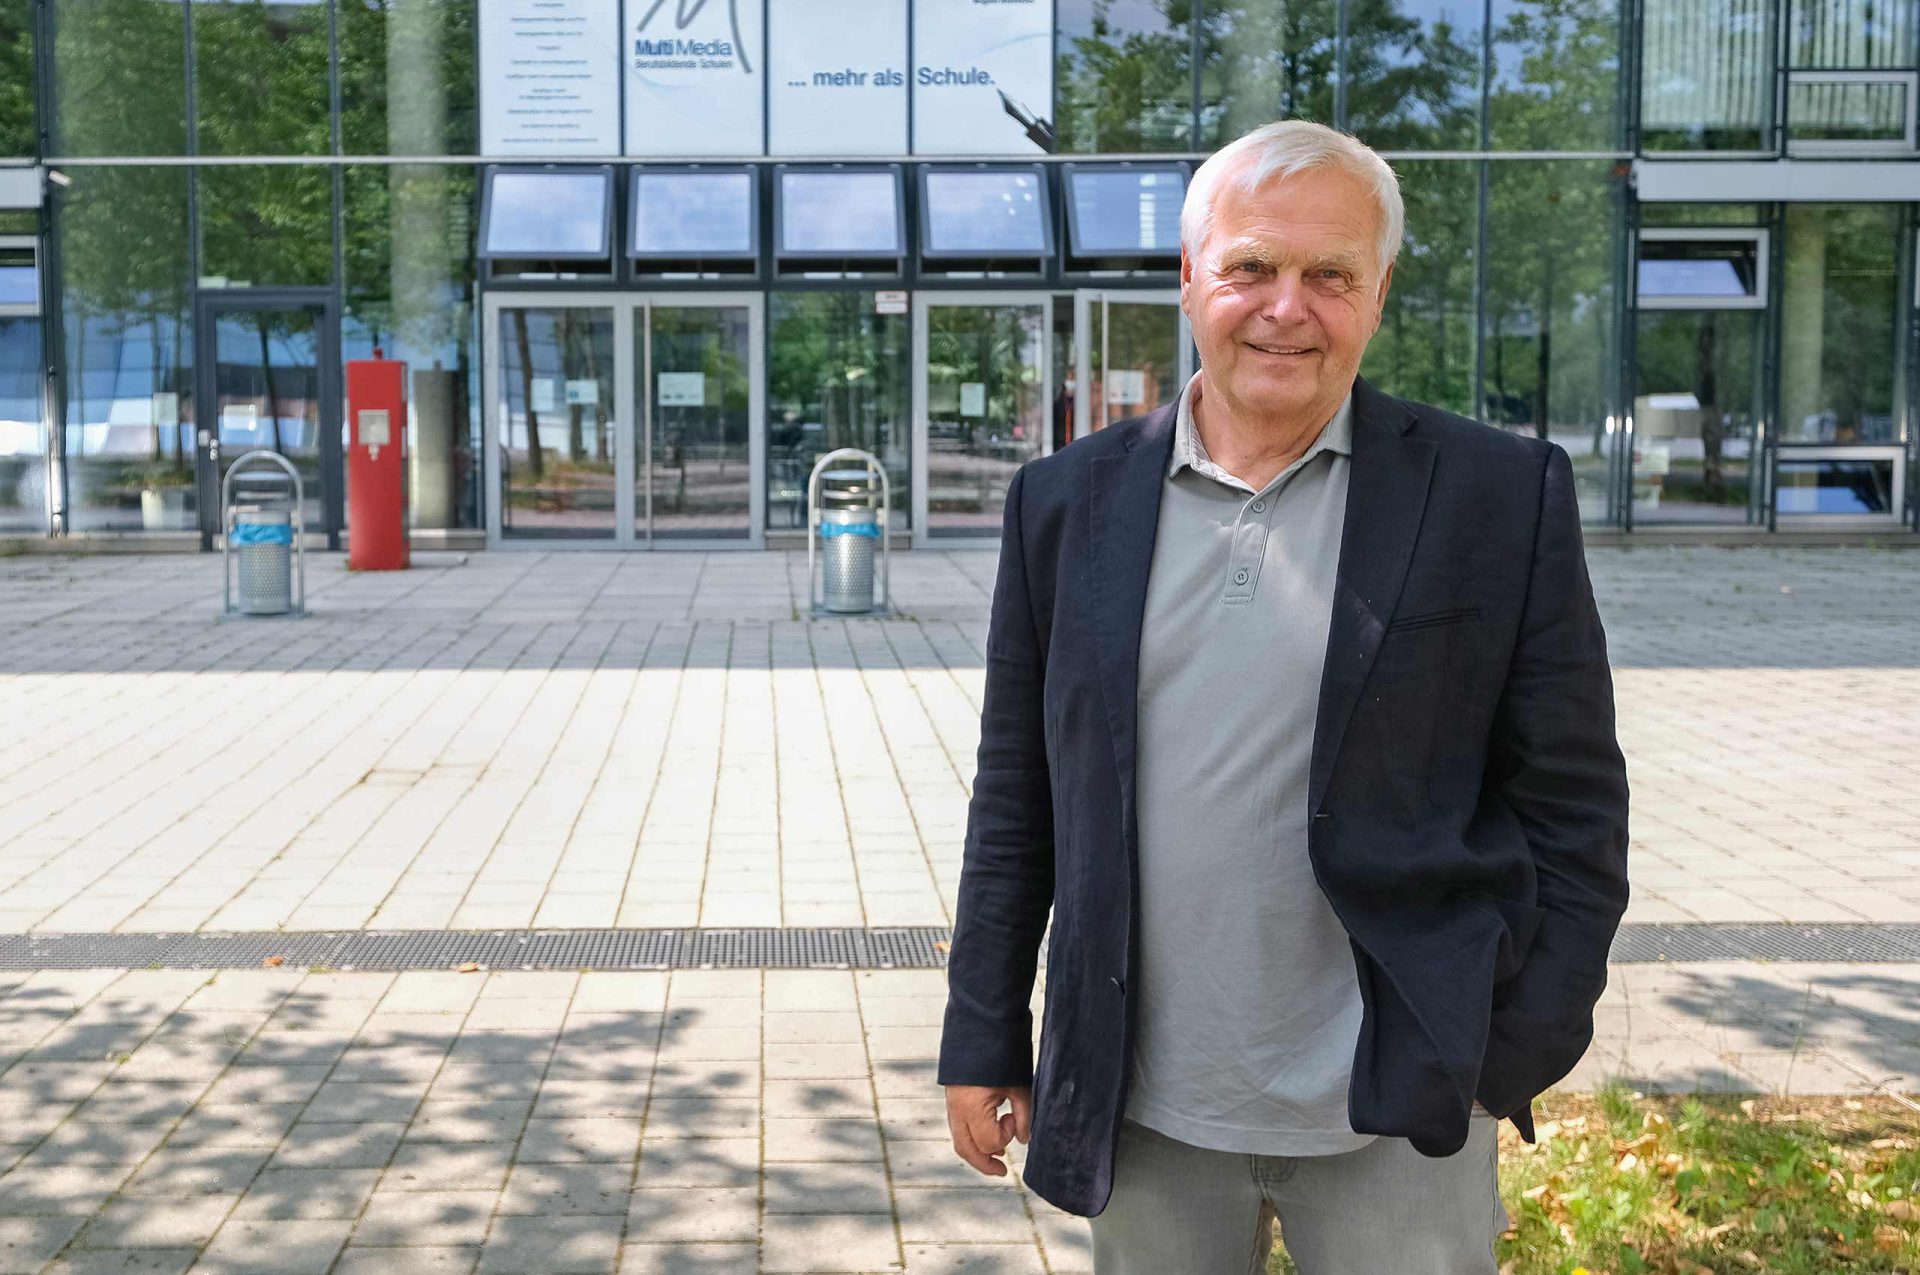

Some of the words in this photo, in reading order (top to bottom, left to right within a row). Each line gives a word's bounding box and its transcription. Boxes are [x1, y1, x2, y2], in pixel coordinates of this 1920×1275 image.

[813, 68, 868, 86] mehr
[873, 68, 904, 86] als
[917, 66, 996, 86] Schule.
